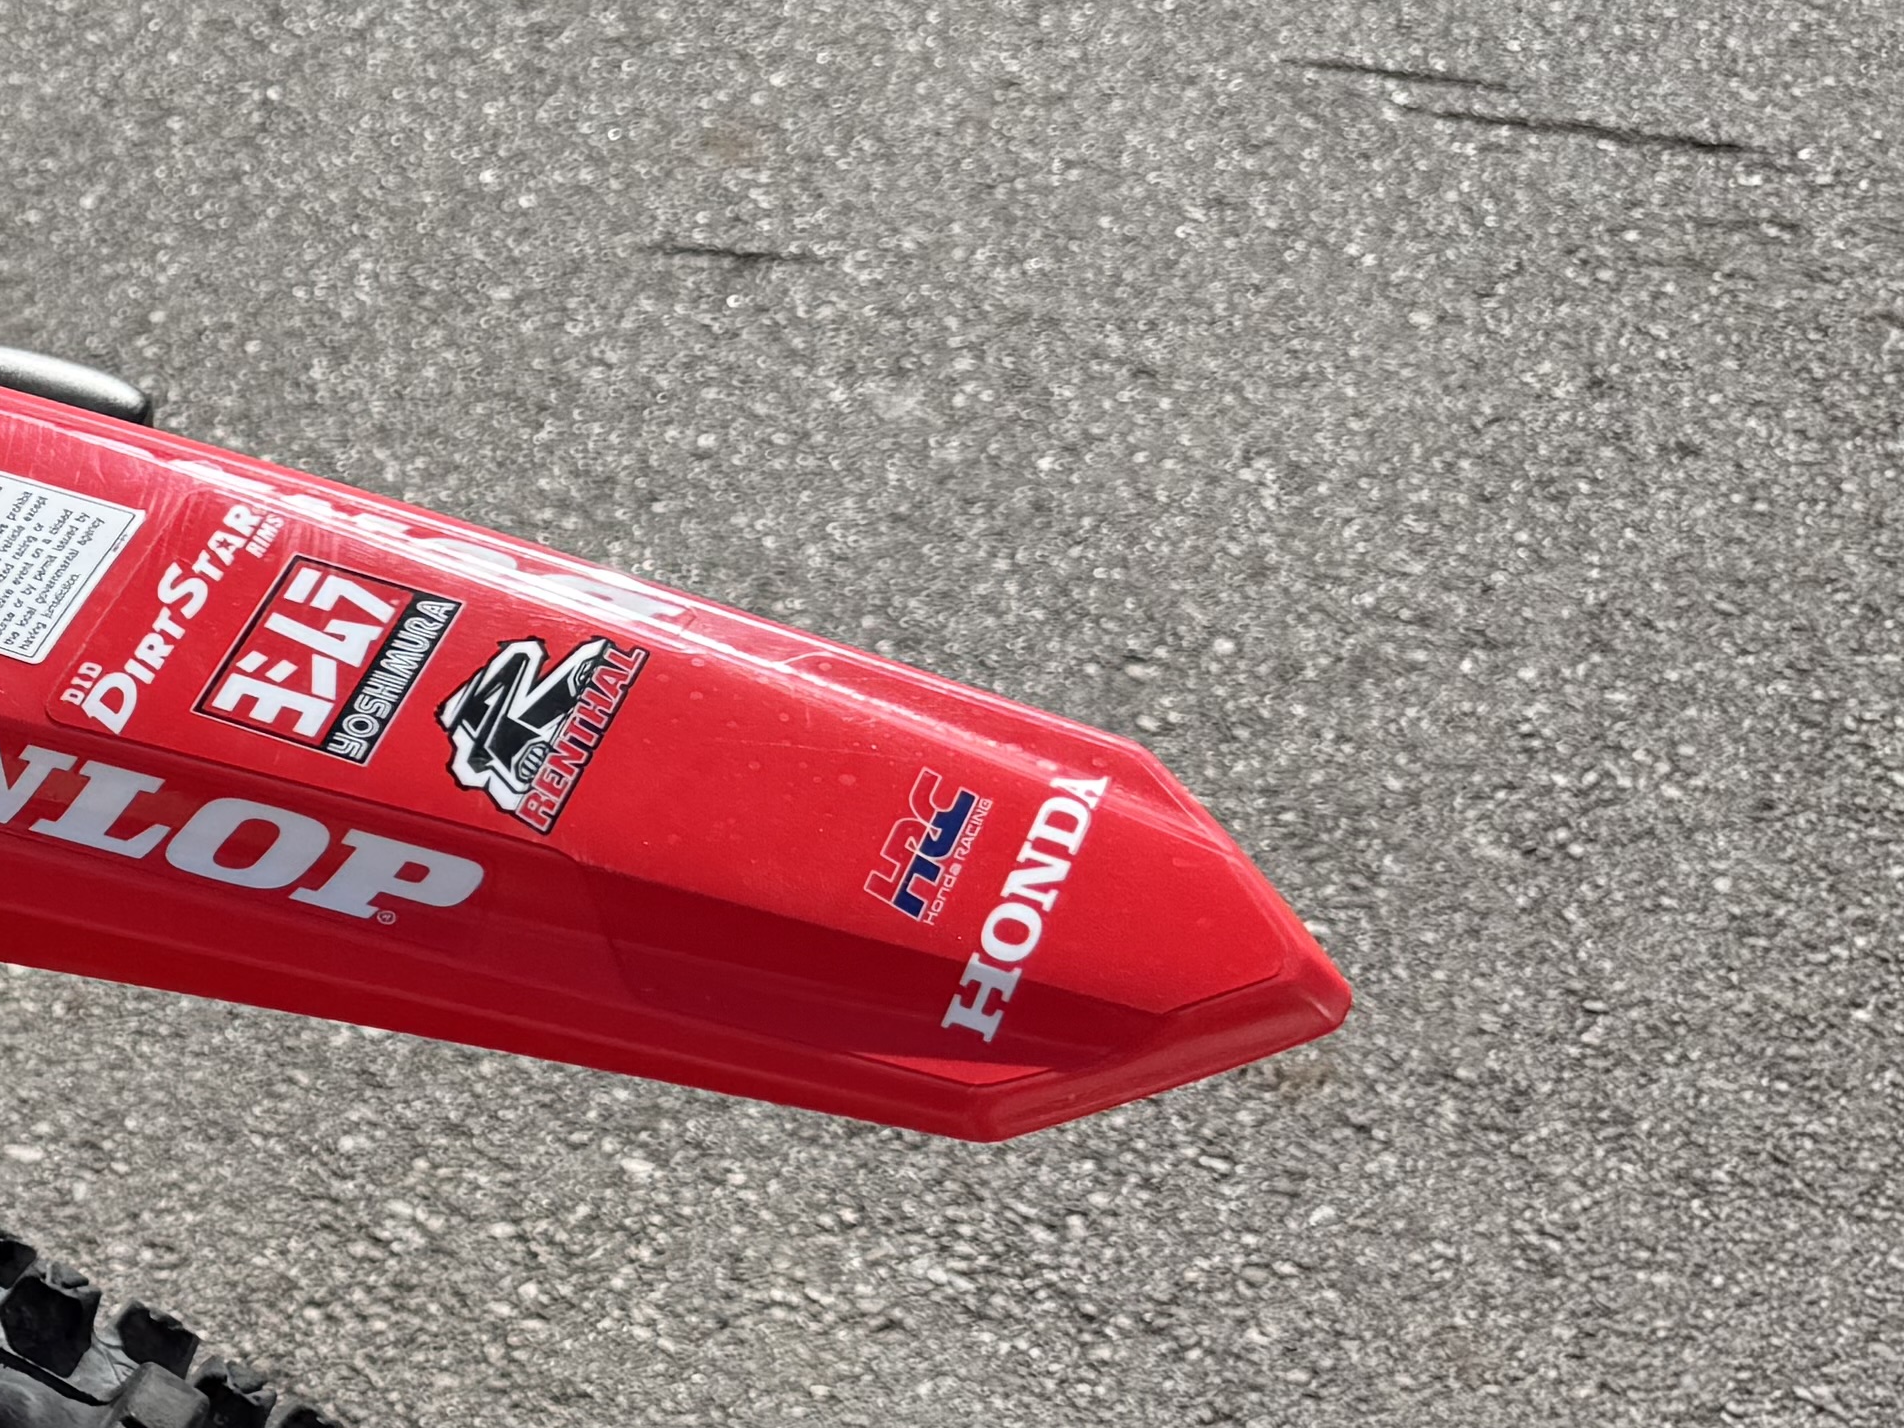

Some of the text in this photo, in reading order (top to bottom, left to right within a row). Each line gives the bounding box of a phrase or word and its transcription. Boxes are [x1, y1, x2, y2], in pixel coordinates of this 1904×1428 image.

[245, 513, 285, 559] RIMS
[60, 661, 103, 707] DID
[327, 600, 458, 761] YOSHIMURA
[515, 648, 646, 833] RENTHAL
[863, 766, 980, 923] HRC
[923, 798, 993, 925] Honda RACING
[940, 775, 1112, 1043] HONDA
